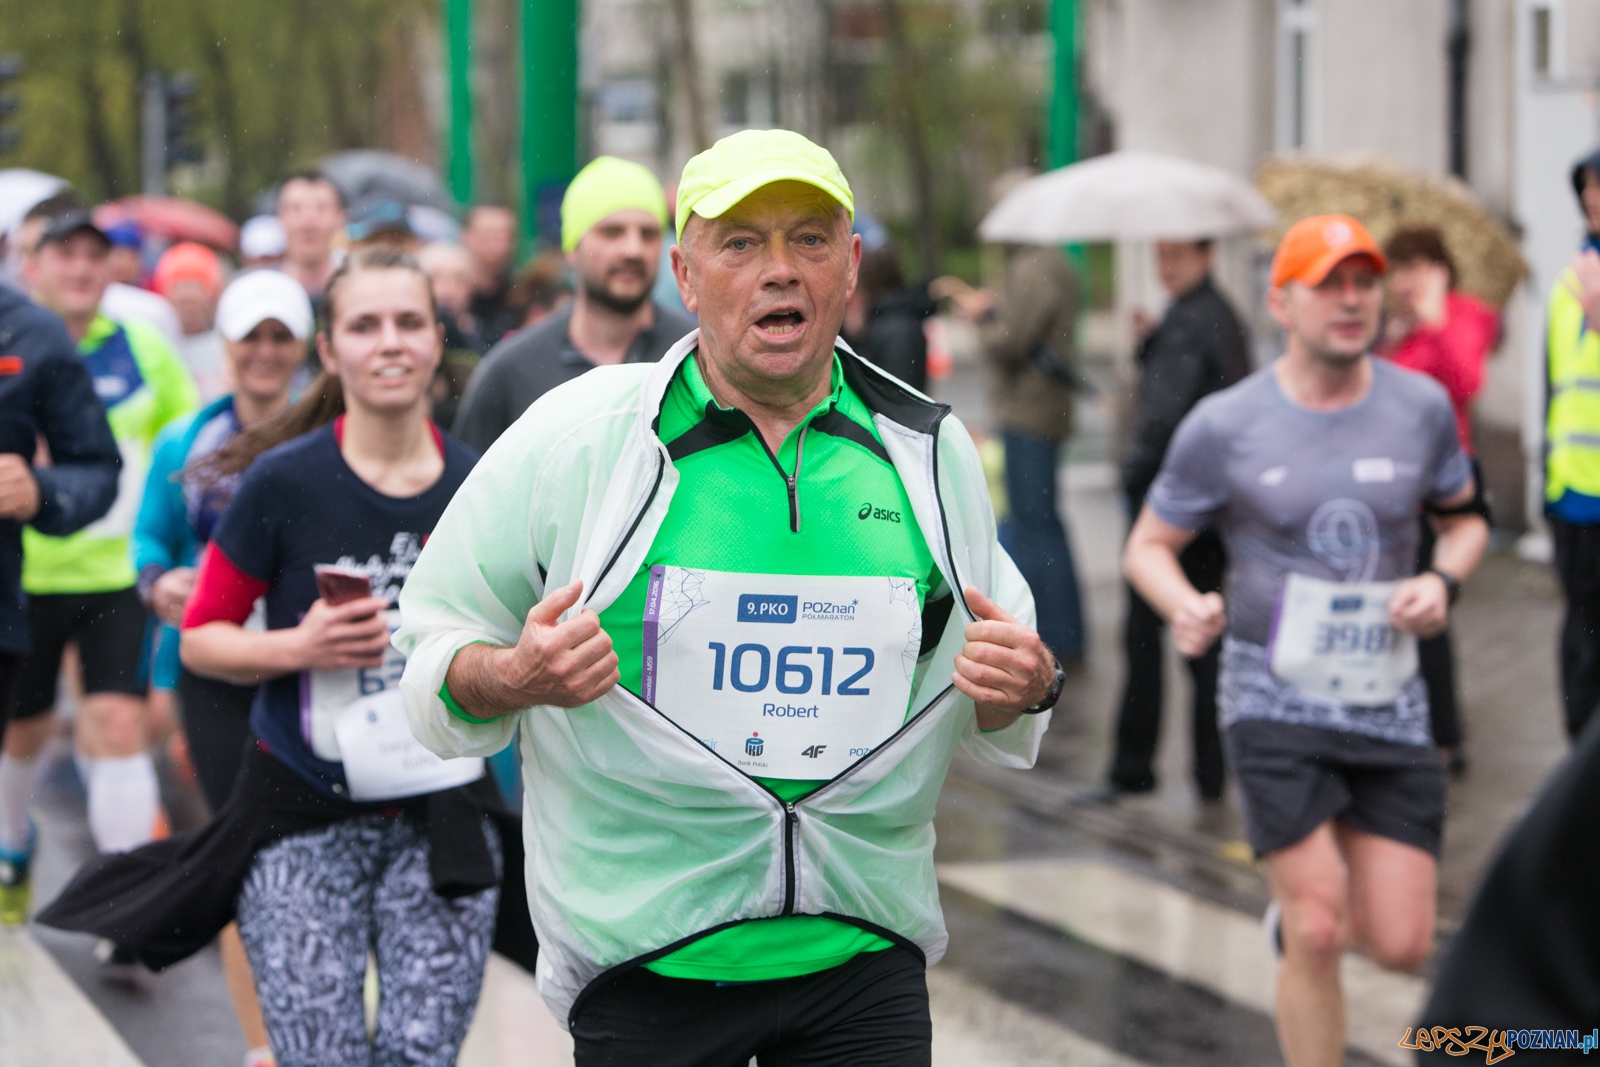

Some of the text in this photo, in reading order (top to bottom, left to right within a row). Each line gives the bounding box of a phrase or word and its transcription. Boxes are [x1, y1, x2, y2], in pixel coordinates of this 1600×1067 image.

[648, 580, 660, 616] 17.04.2016
[747, 602, 789, 616] 9. PKO
[802, 612, 855, 621] PÓŁMARATON
[708, 641, 875, 696] 10612
[763, 703, 819, 718] Robert
[801, 745, 827, 758] 4F
